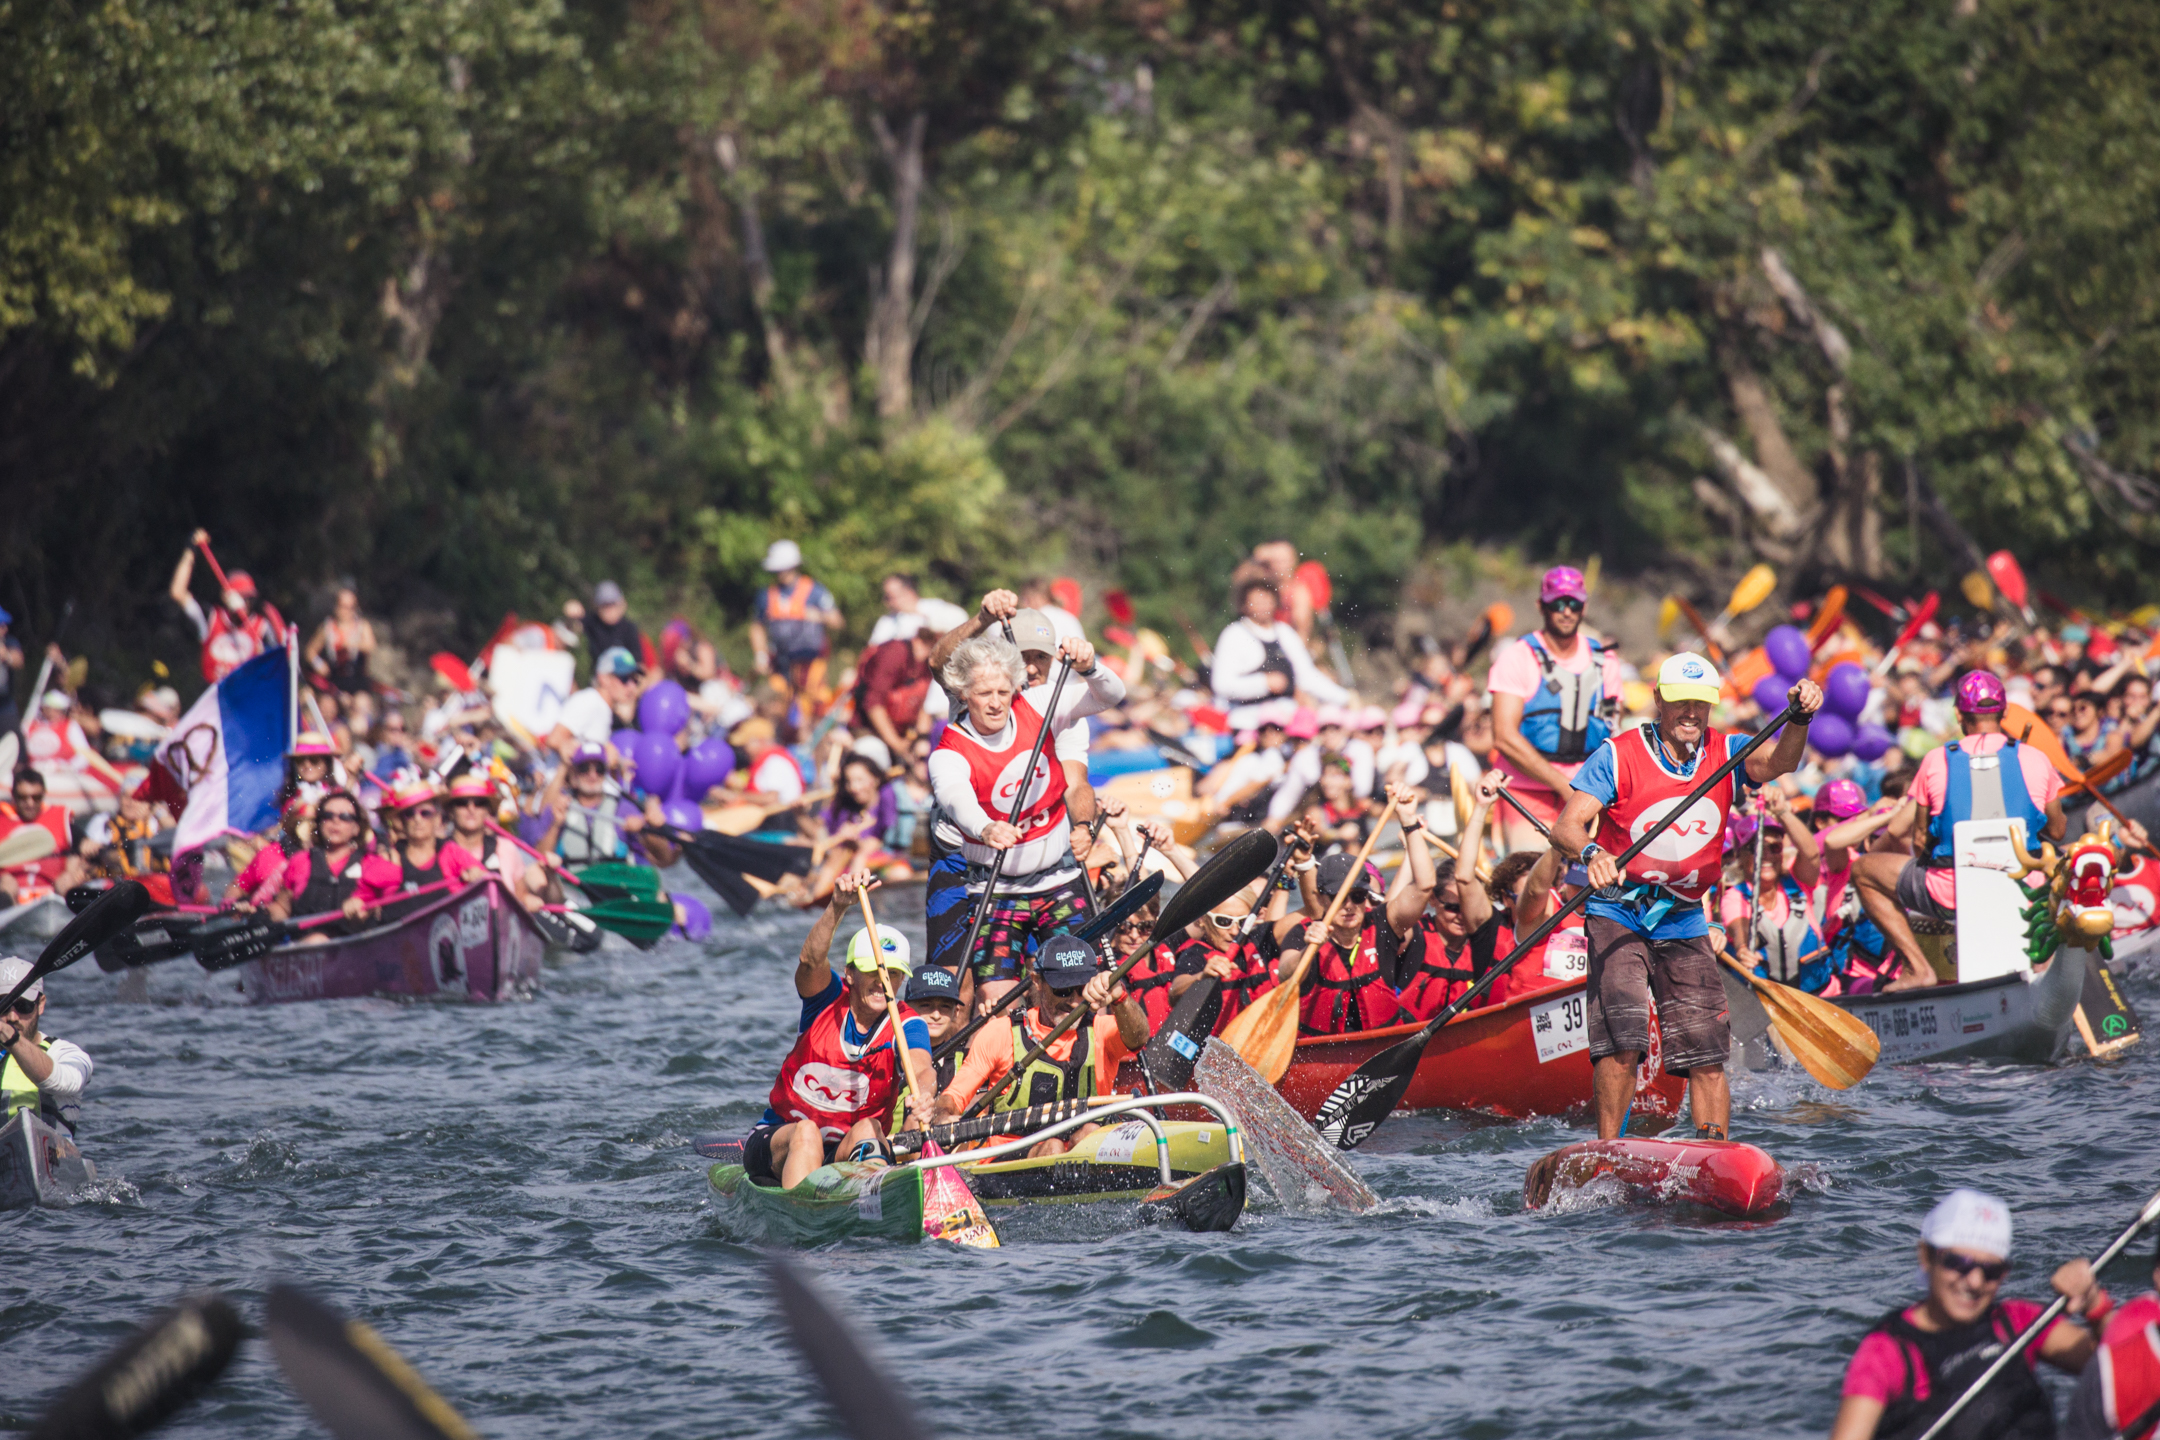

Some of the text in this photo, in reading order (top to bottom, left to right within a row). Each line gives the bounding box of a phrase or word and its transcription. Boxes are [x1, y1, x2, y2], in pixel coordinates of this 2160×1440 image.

[1061, 957, 1085, 968] RACE
[1565, 954, 1586, 972] 39
[927, 977, 950, 988] RACE
[1562, 997, 1583, 1032] 39
[804, 1073, 859, 1103] CNR
[1054, 1159, 1090, 1179] NELO
